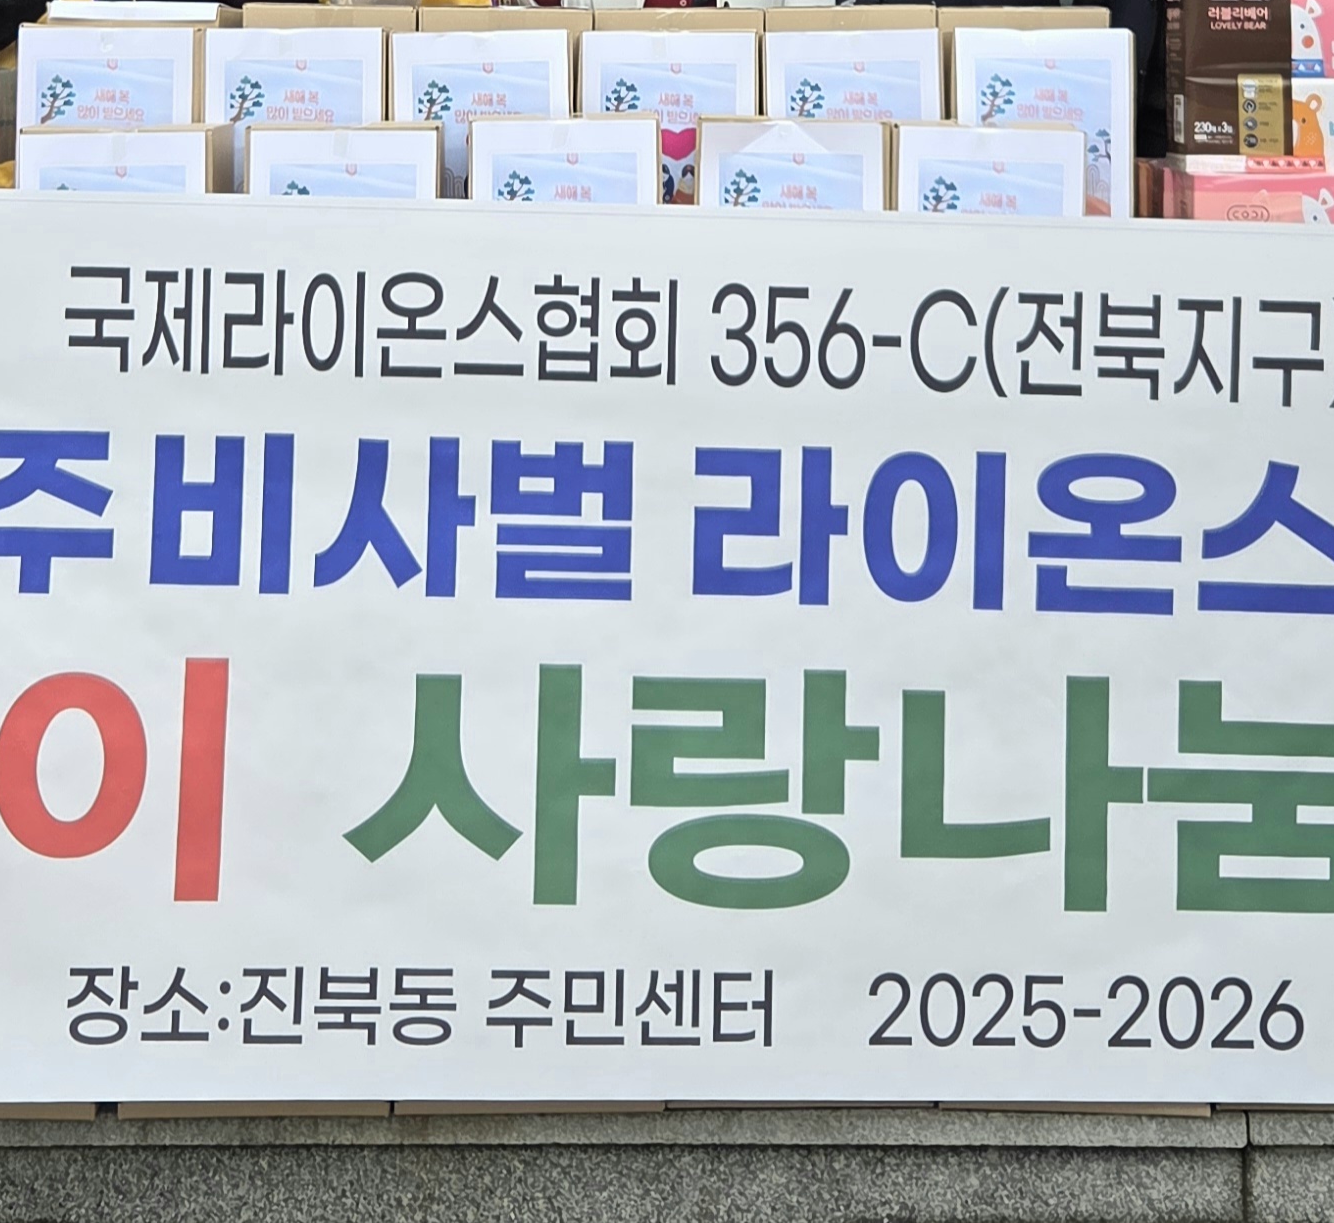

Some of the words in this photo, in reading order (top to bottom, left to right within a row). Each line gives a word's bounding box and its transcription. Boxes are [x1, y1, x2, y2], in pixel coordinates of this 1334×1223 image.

[1207, 5, 1269, 21] 러블리베어
[1210, 20, 1242, 31] LOVELY
[1244, 21, 1267, 30] BEAR
[64, 265, 678, 386] 국제라이온스협회
[65, 965, 457, 1048] 장소:진북동
[485, 967, 774, 1049] 주민센터
[866, 970, 1306, 1052] 2025-2026
